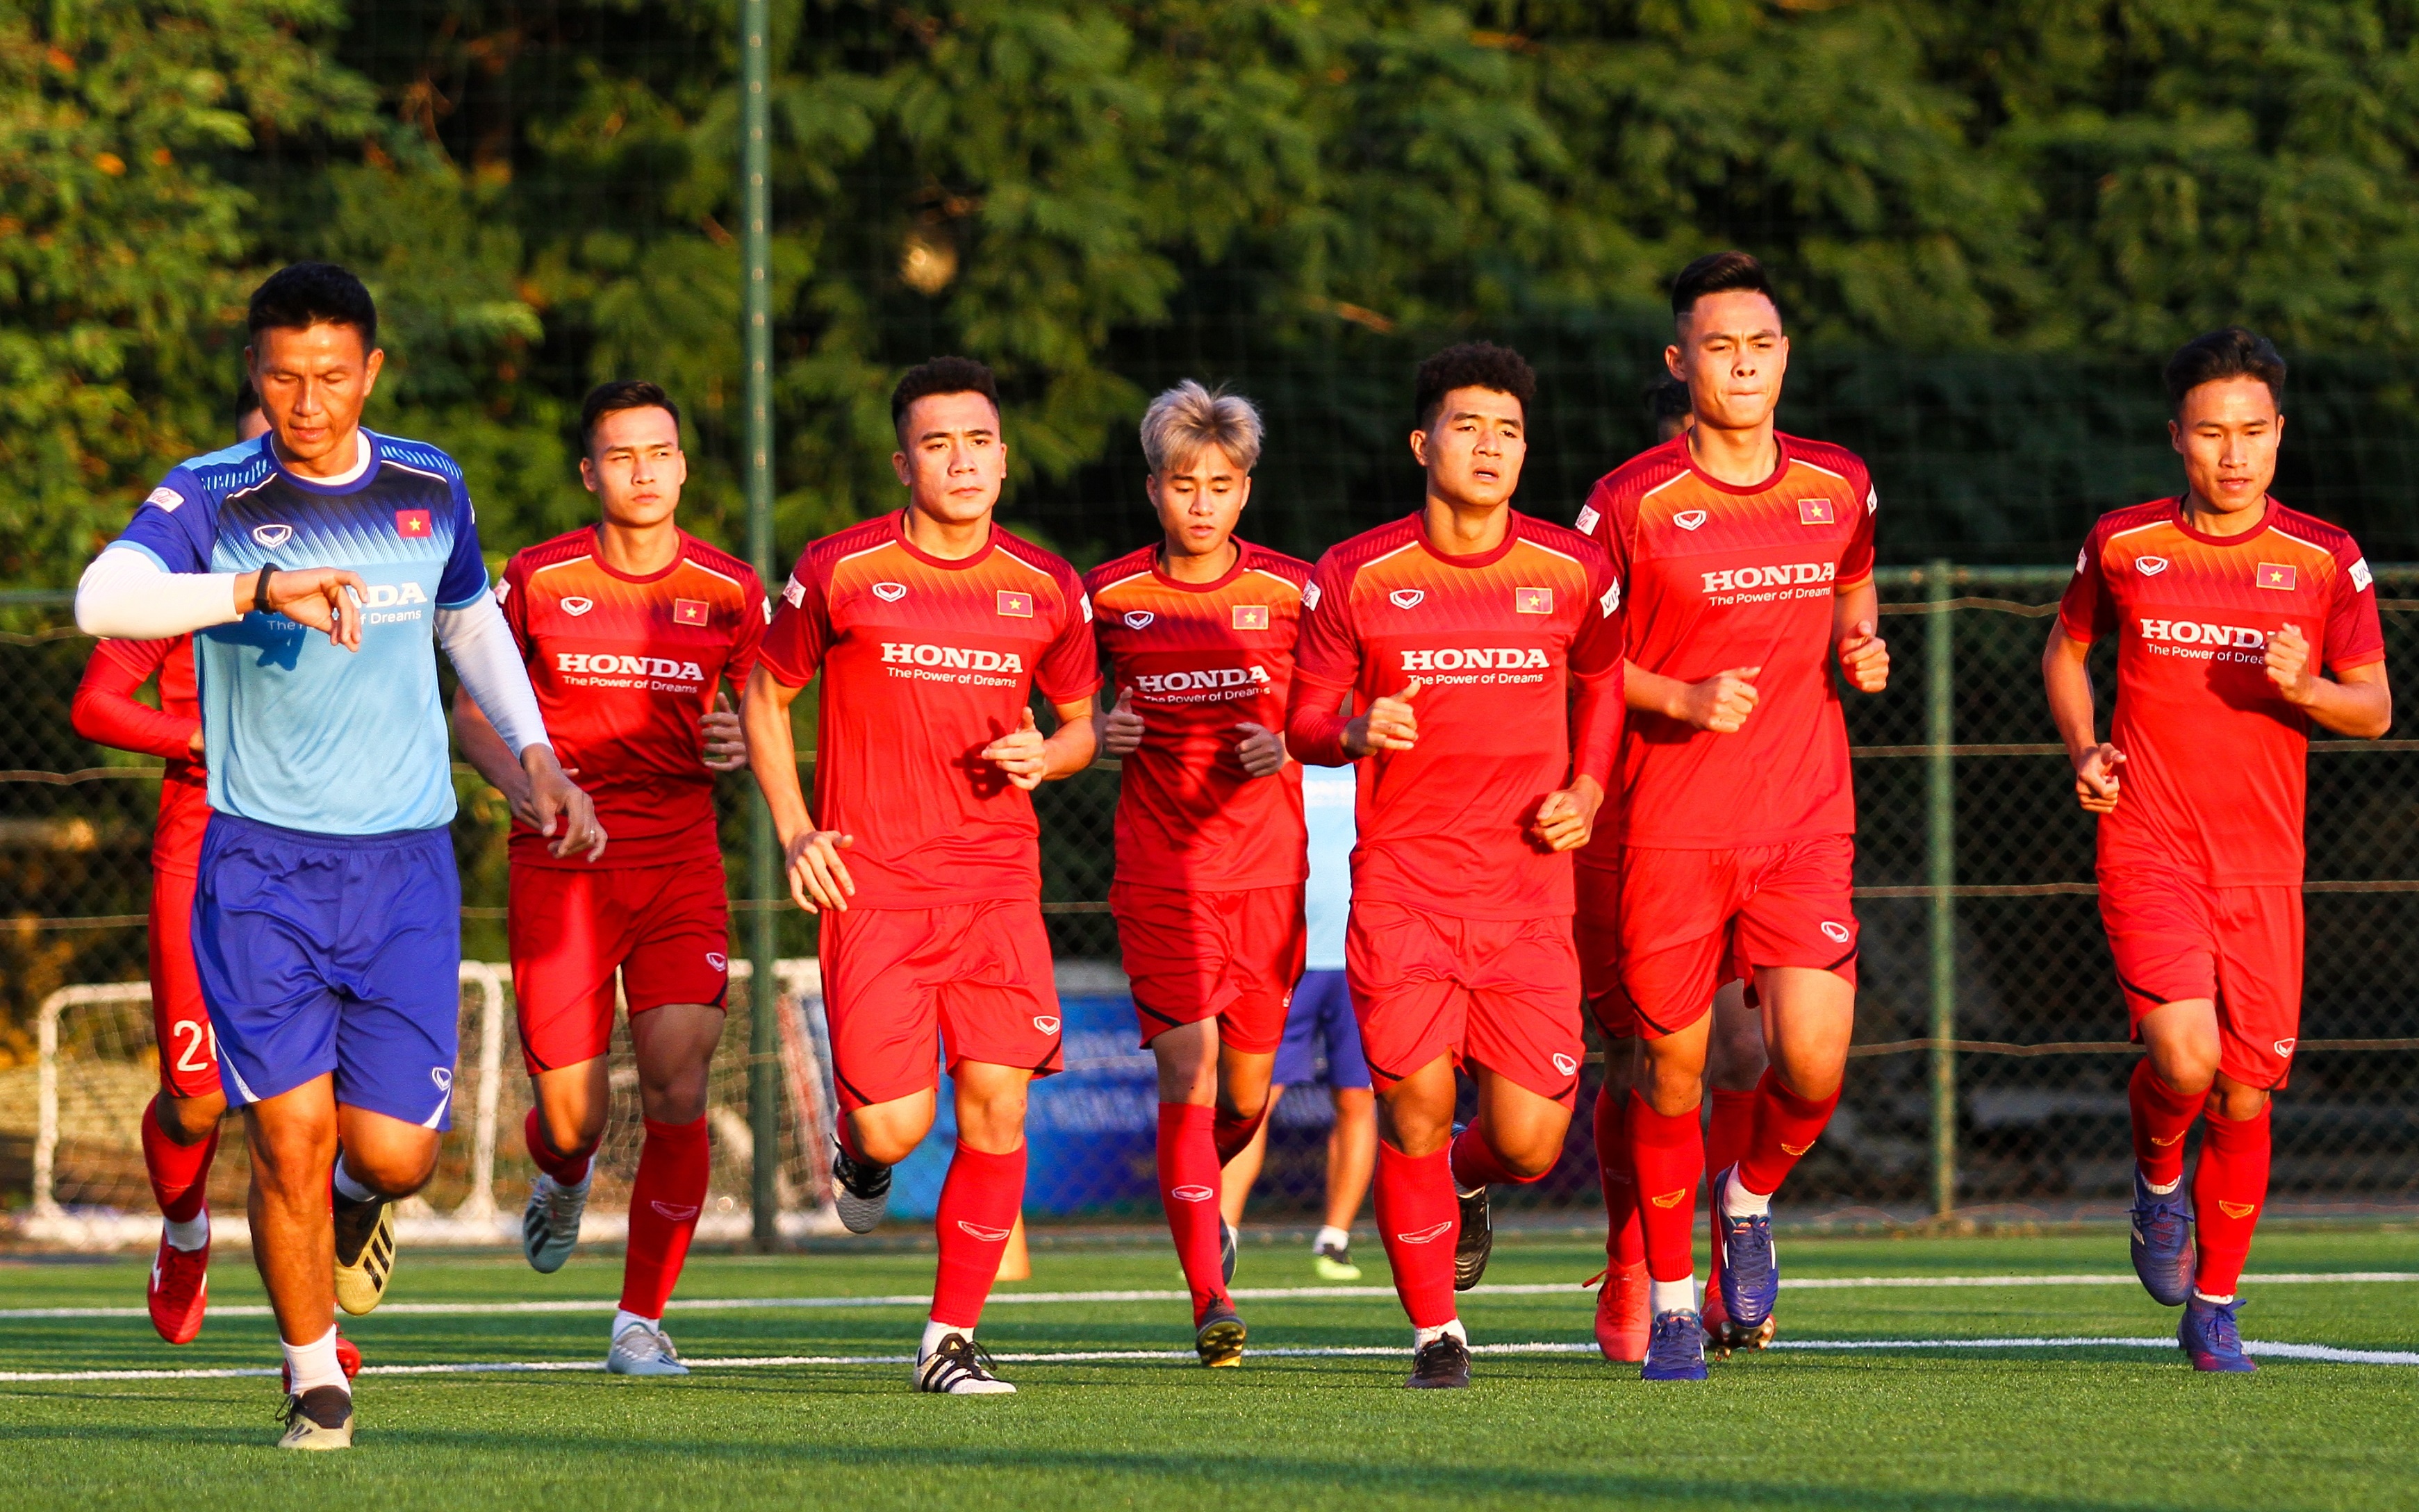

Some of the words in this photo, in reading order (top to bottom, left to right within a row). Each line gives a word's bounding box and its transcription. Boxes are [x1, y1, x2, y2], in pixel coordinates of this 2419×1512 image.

[1701, 562, 1835, 593] HONDA
[1708, 595, 1734, 606] The
[1736, 591, 1777, 604] Power
[1779, 588, 1793, 600] of
[1795, 586, 1831, 599] Dreams
[267, 620, 295, 631] The
[370, 609, 422, 624] Dreams
[2140, 618, 2273, 649] HOND
[881, 642, 1023, 673] HONDA
[1401, 648, 1550, 670] HONDA
[2146, 643, 2170, 656] The
[2172, 646, 2214, 660] Power
[2217, 651, 2231, 661] of
[556, 653, 704, 681] HONDA
[886, 667, 911, 678] The
[914, 668, 956, 682] Power
[958, 674, 972, 684] of
[973, 675, 1016, 688] Dreams
[563, 675, 588, 686] The
[589, 676, 633, 688] Power
[634, 679, 648, 689] of
[650, 681, 697, 694] Dreams
[1135, 665, 1271, 692] HONDA
[1435, 674, 1478, 684] Power
[1480, 674, 1495, 683] of
[1499, 673, 1544, 683] Dreams
[1167, 694, 1206, 704] Power
[1209, 692, 1221, 701] of
